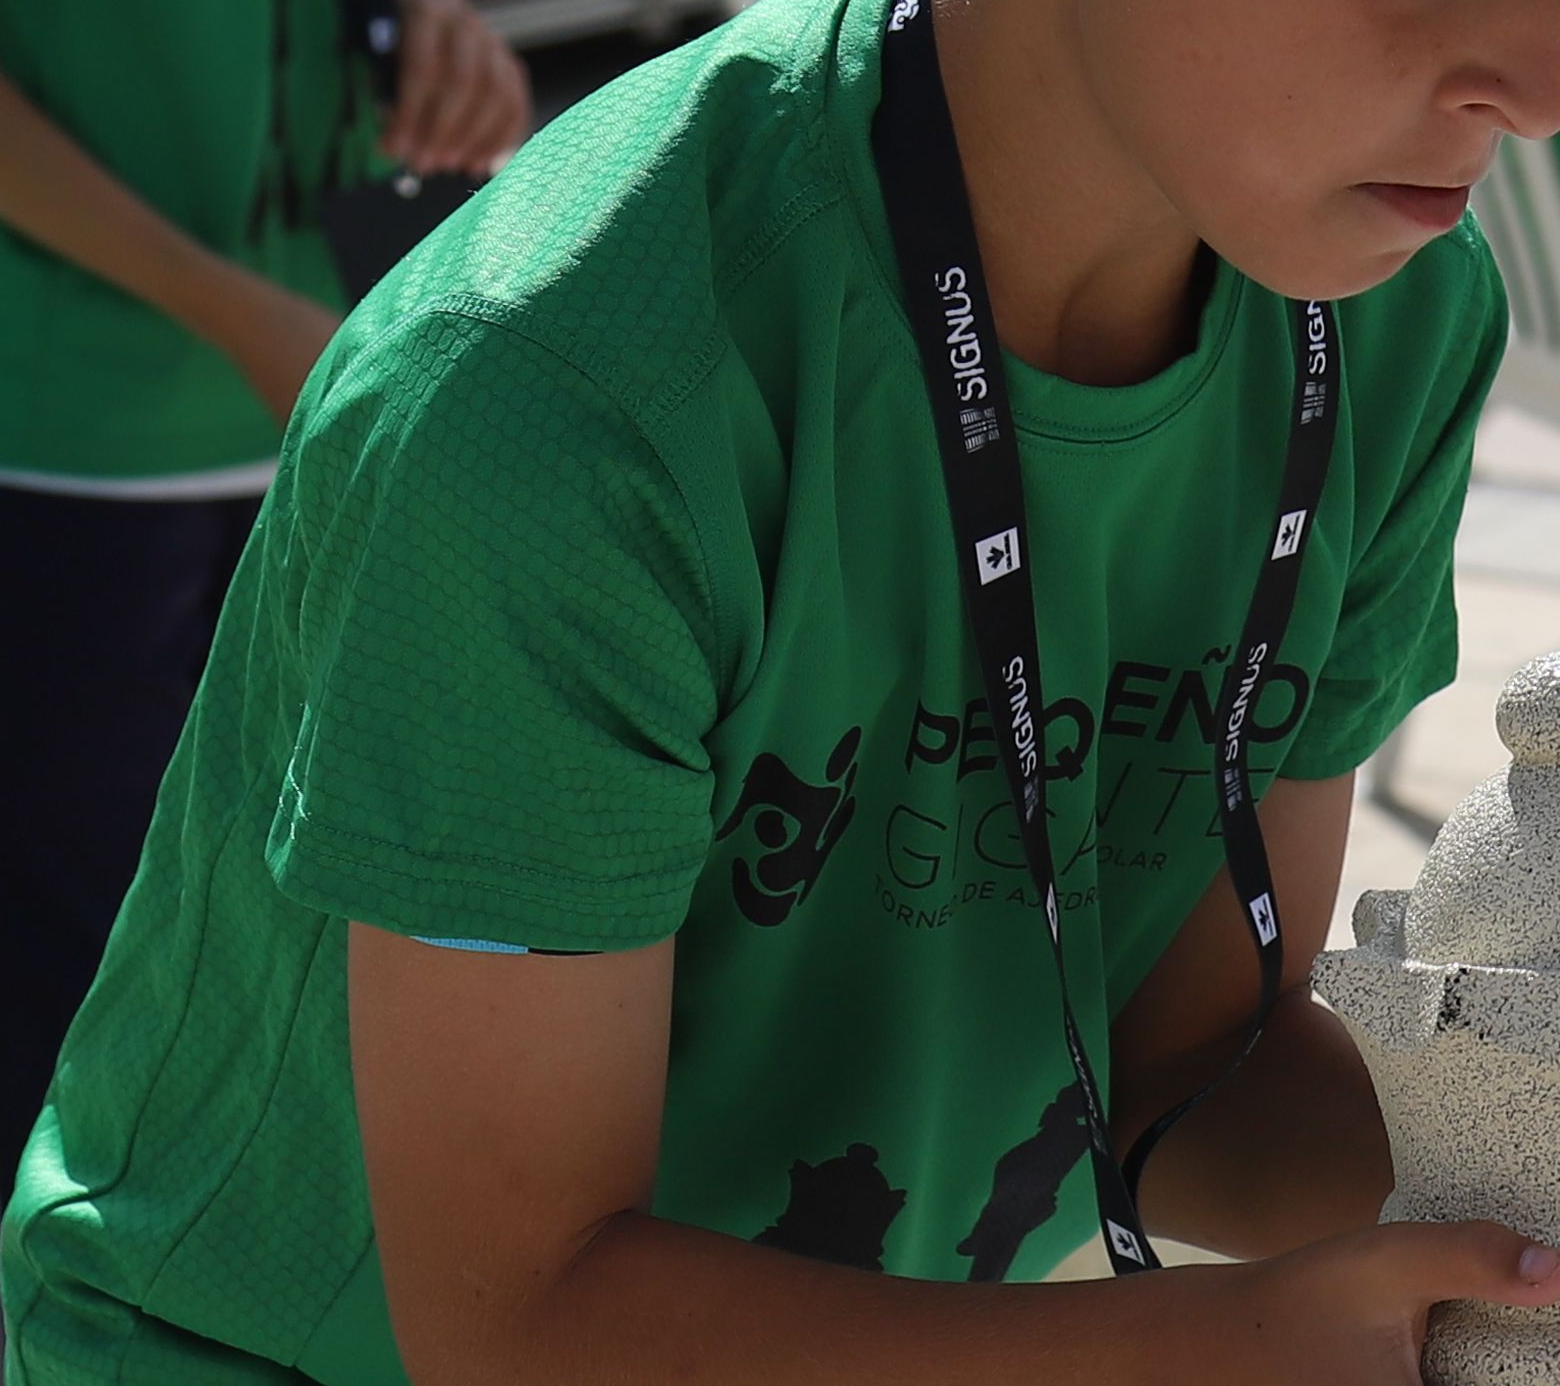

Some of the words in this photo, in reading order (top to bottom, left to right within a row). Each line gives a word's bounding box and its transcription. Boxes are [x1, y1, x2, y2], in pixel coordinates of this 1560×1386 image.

[935, 266, 988, 401] SIGNUS
[1306, 299, 1327, 375] SIGN
[1002, 655, 1037, 778] SIGNUS
[1225, 642, 1268, 762] SIGNUS
[962, 880, 997, 904] DE
